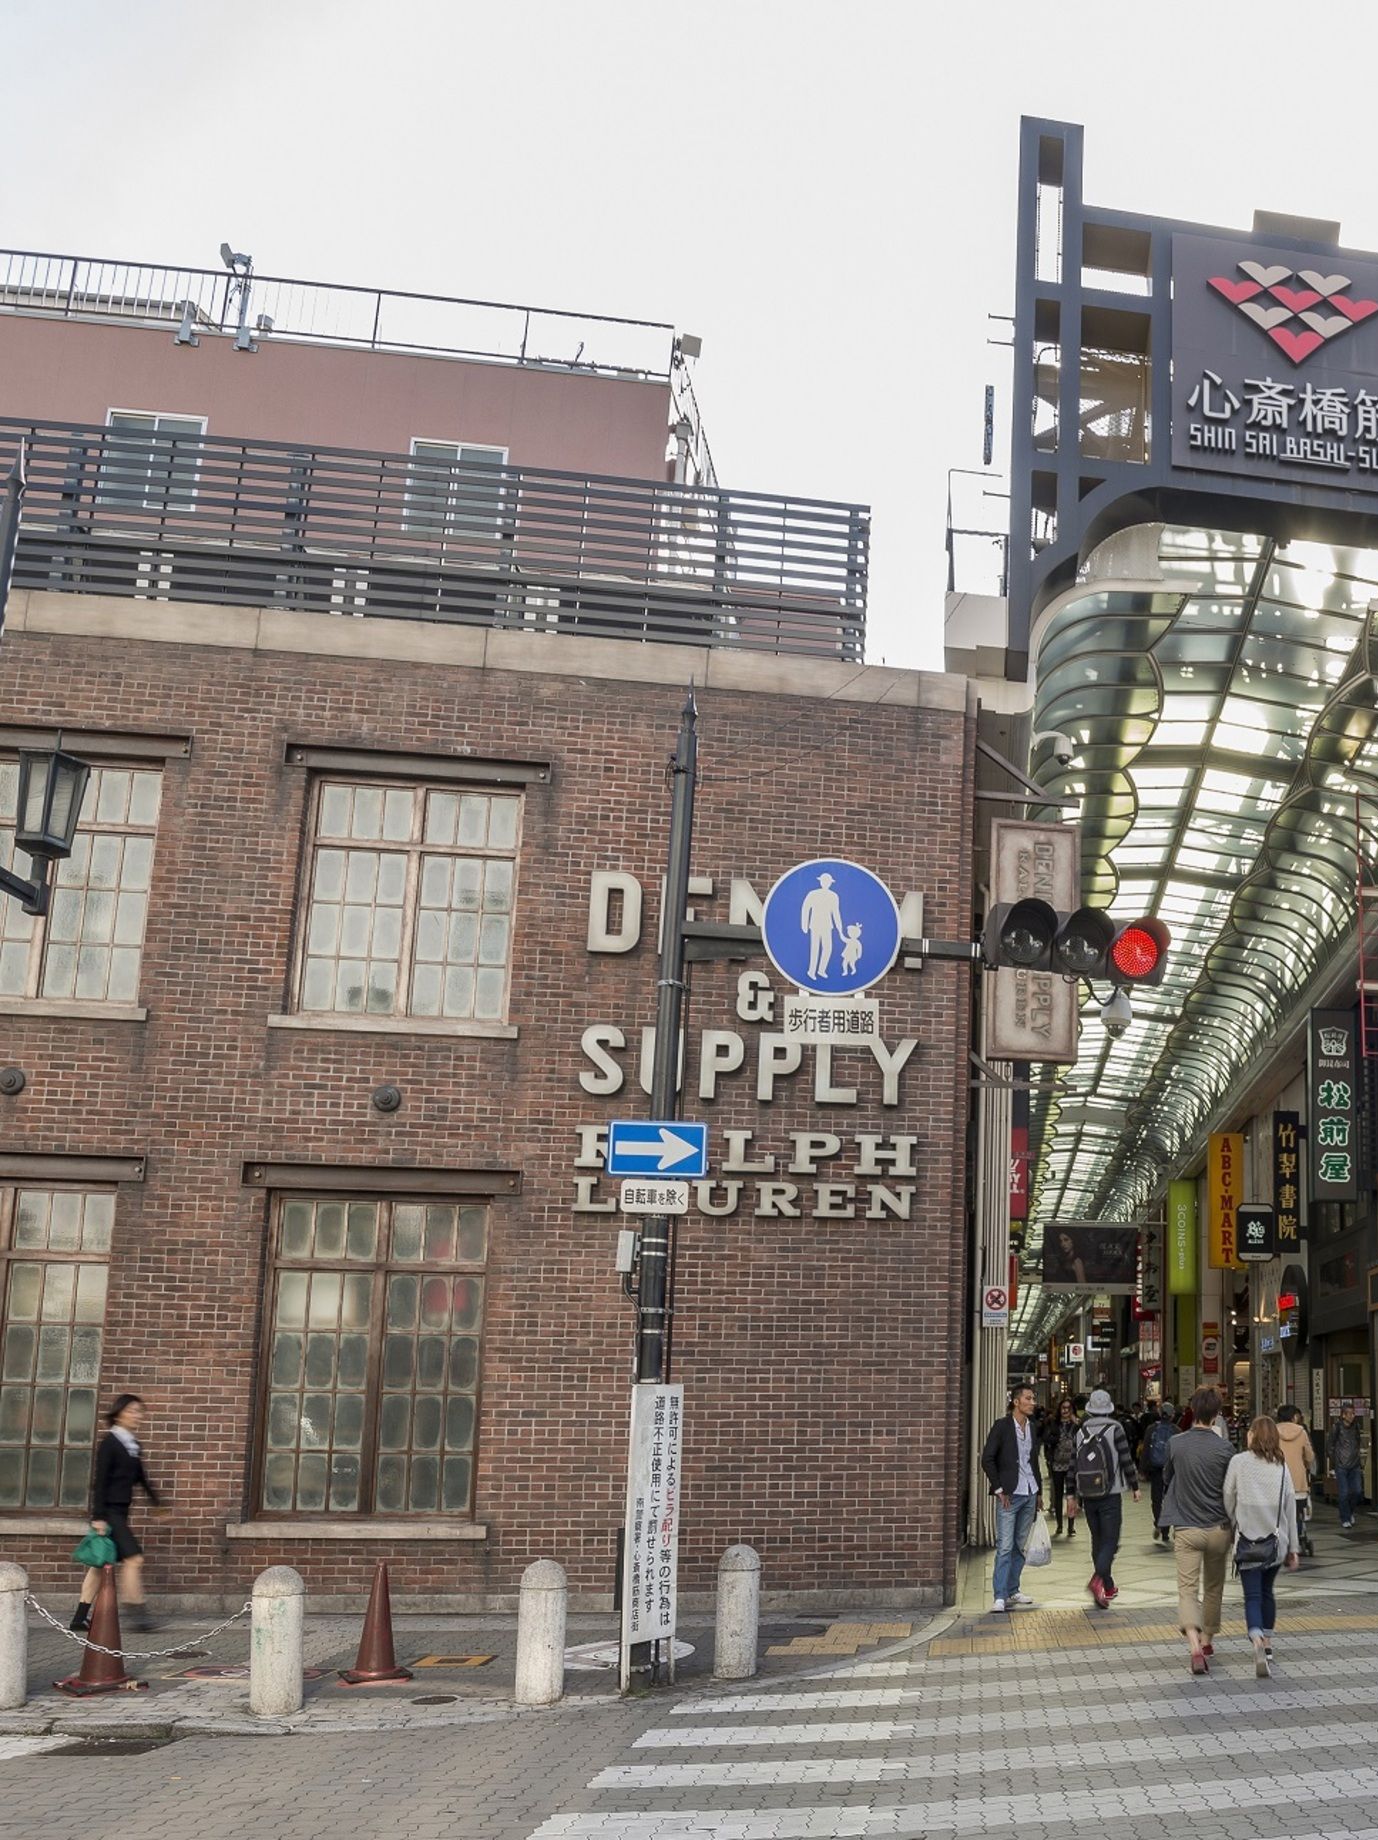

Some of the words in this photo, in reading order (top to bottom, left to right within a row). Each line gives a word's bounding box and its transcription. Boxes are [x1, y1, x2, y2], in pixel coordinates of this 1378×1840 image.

[1190, 424, 1236, 450] SHIN
[736, 970, 774, 1022] &
[788, 1008, 875, 1035] 歩行者用道路
[574, 1125, 918, 1177] RLPH
[1317, 1079, 1351, 1182] 松前屋
[571, 1176, 916, 1221] LUREN
[624, 1187, 685, 1206] 自転車を除く
[659, 1396, 680, 1627] 無許可によるビラ配り等の行為は
